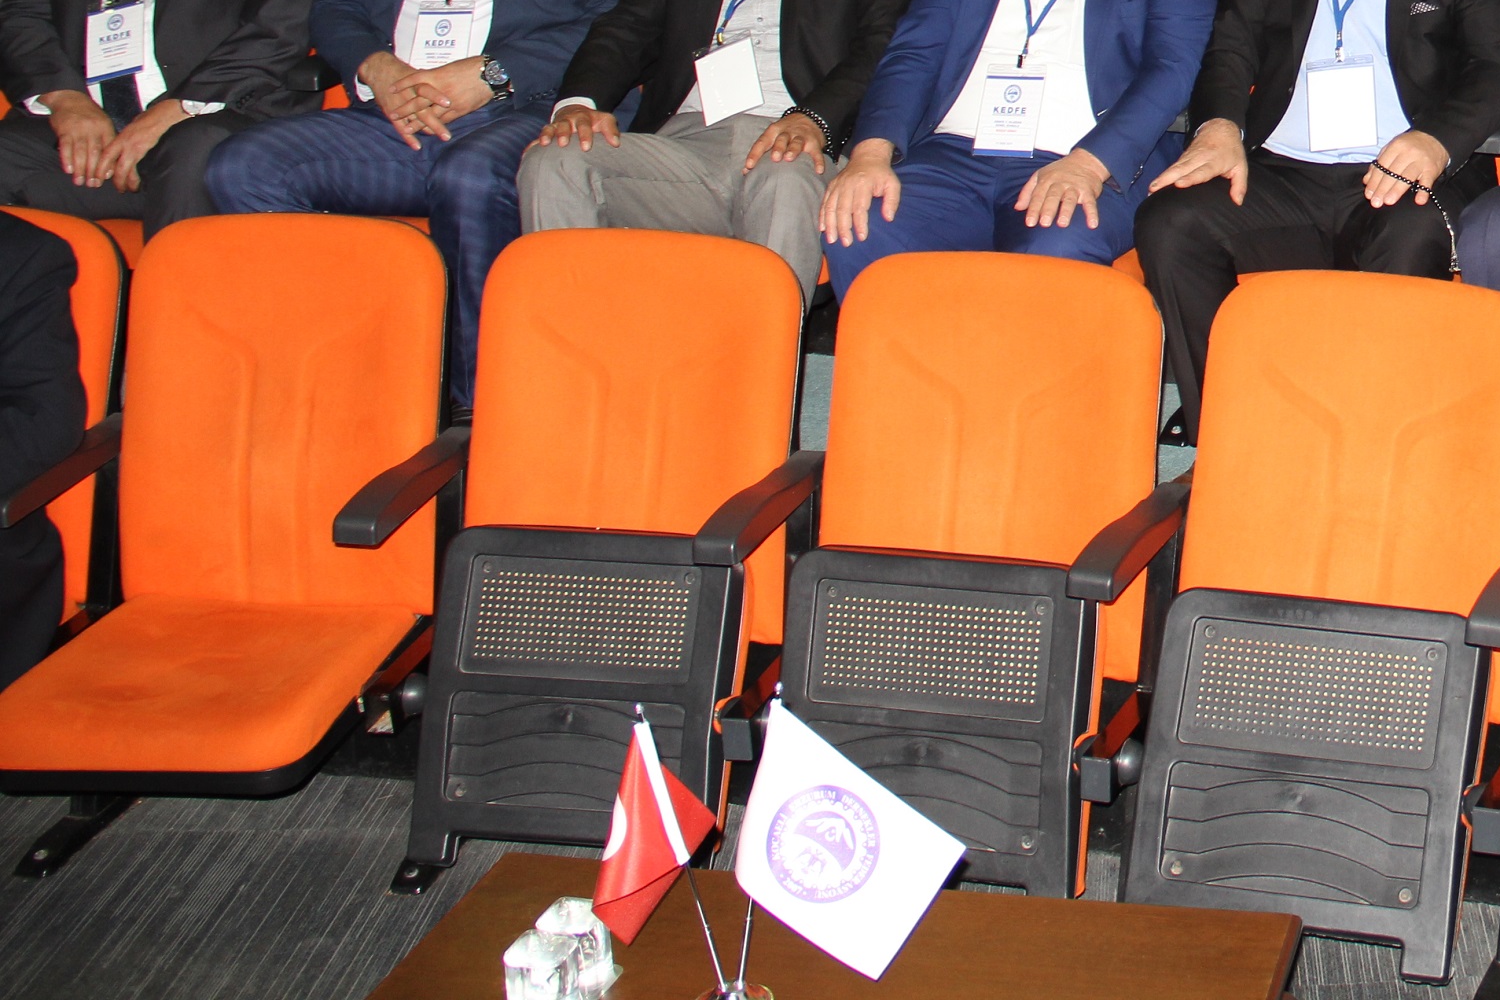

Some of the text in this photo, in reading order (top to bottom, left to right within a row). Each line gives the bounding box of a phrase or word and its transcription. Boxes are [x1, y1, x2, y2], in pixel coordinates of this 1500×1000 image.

[99, 30, 131, 42] KEDFE
[425, 39, 456, 47] KEDFE
[993, 106, 1027, 115] KEDFE
